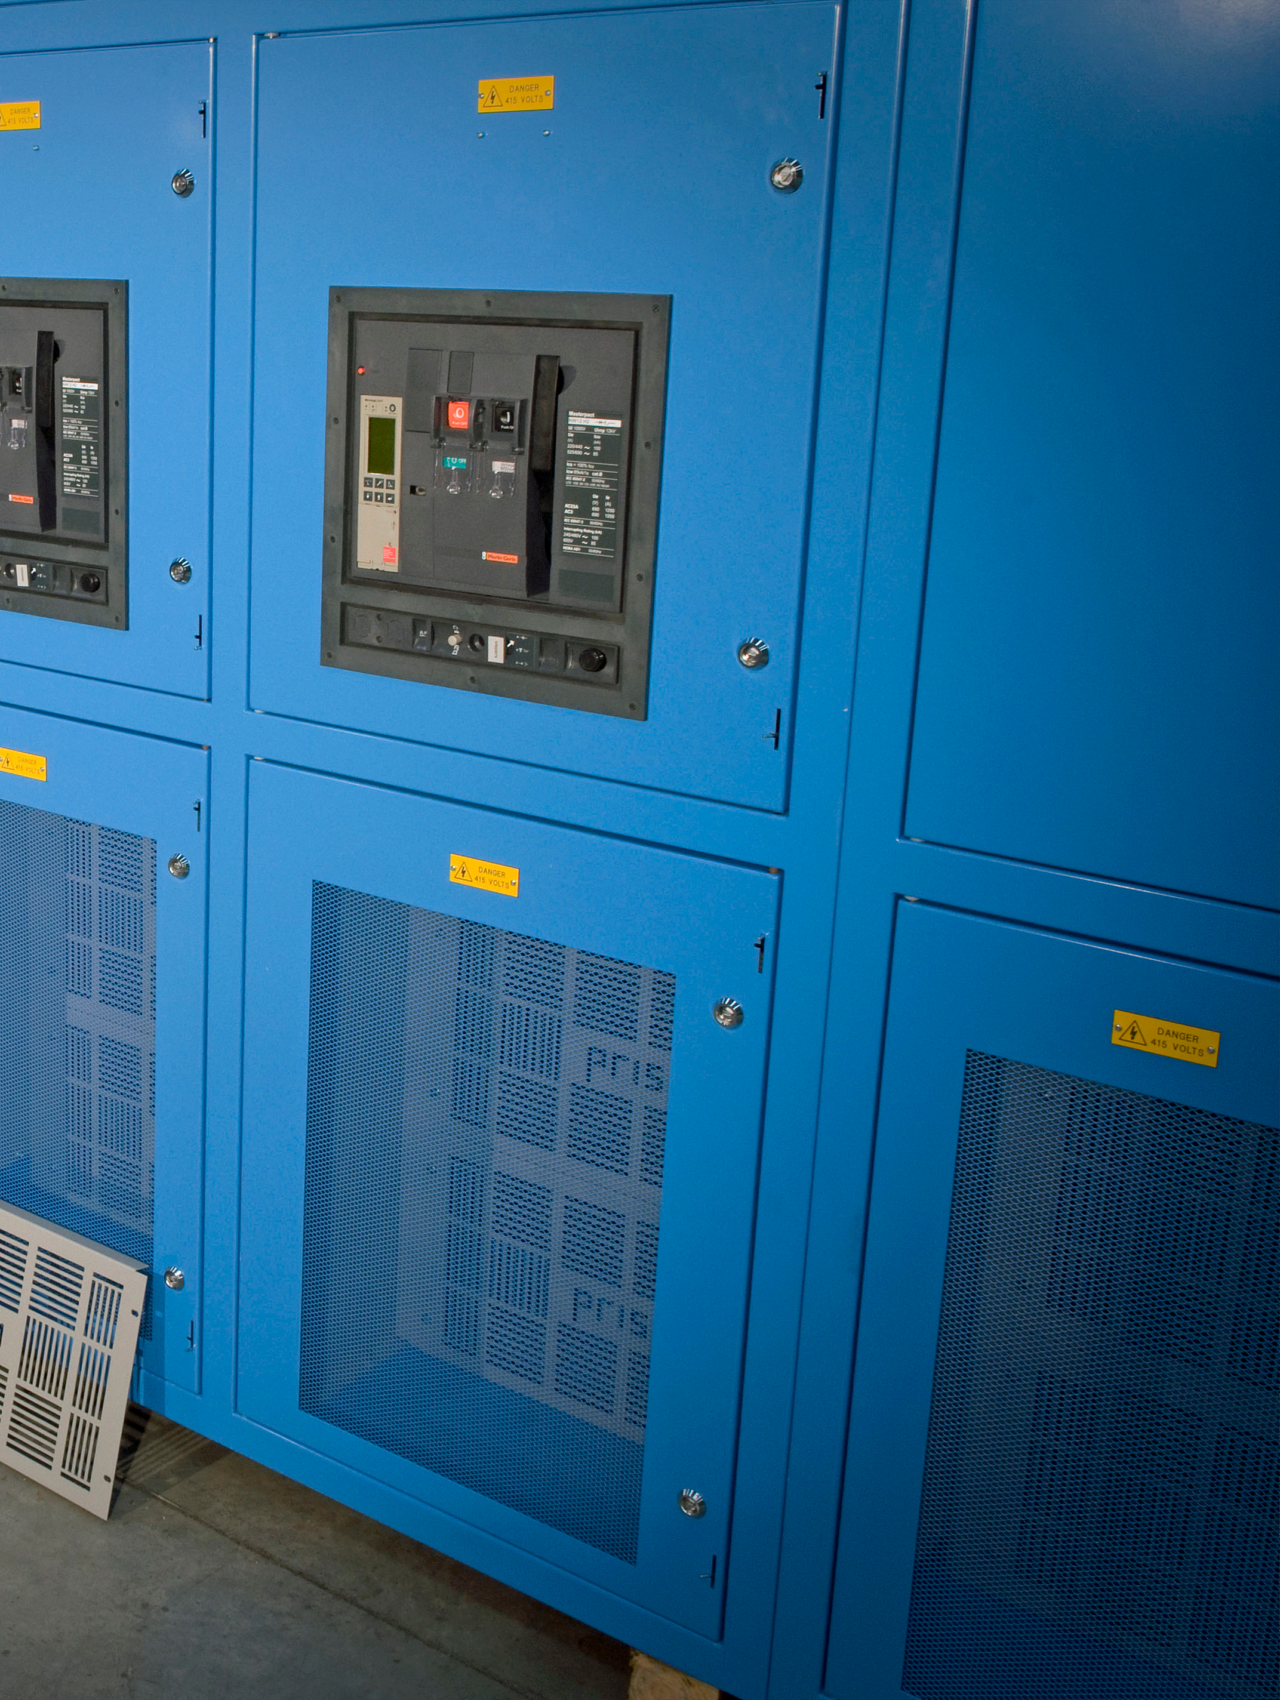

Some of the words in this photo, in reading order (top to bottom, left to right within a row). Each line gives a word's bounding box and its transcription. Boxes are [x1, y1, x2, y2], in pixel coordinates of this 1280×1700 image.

[510, 84, 539, 93] DANGER
[521, 95, 544, 103] VOLTS
[478, 866, 506, 878] DANGER
[489, 879, 509, 889] VOLTS
[1157, 1027, 1199, 1043] DANGER
[1151, 1039, 1167, 1049] 415
[1172, 1043, 1204, 1057] VOLTS
